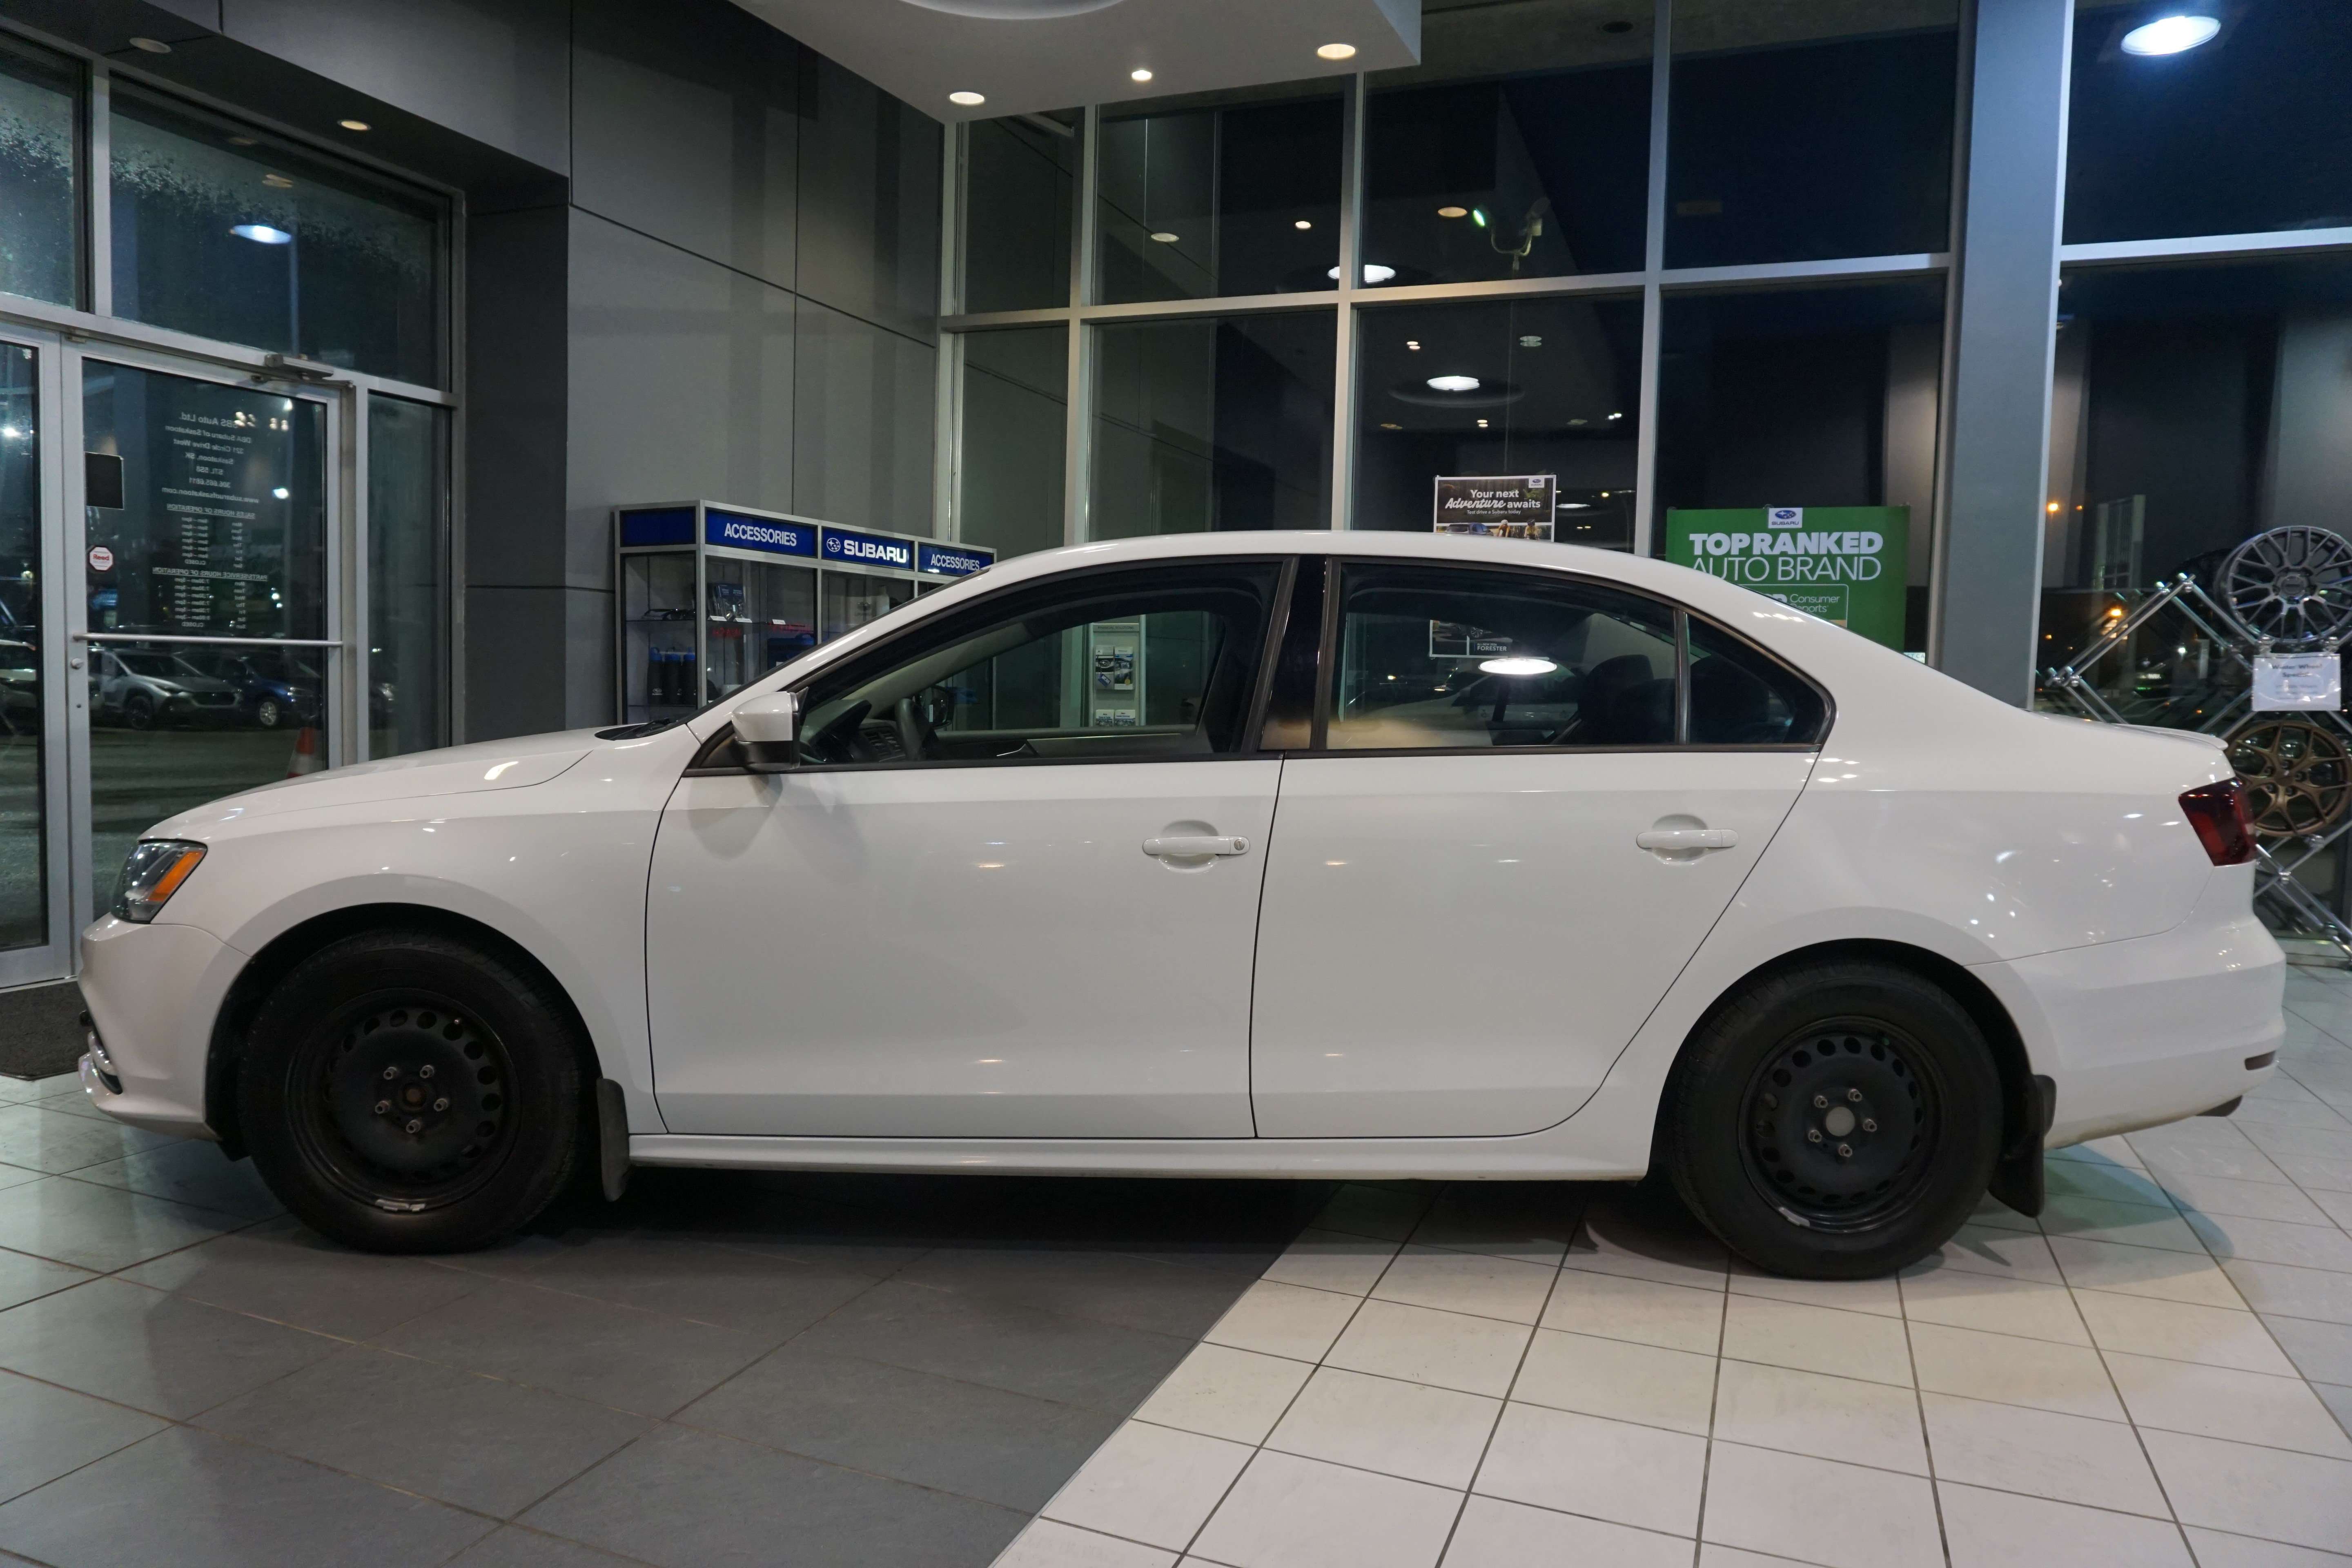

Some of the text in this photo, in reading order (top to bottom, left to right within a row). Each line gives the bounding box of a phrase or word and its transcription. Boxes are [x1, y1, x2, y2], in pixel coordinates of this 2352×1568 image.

[1445, 498, 1541, 509] Adventure awaits
[1470, 490, 1494, 498] Your
[724, 523, 796, 547] ACCESSORIES
[1689, 531, 1883, 556] TOP RANKED
[844, 539, 907, 563] SUBARU
[931, 554, 980, 570] ACCESSORIES
[1693, 556, 1882, 581] AUTO BRAND
[1790, 594, 1840, 603] Consumer
